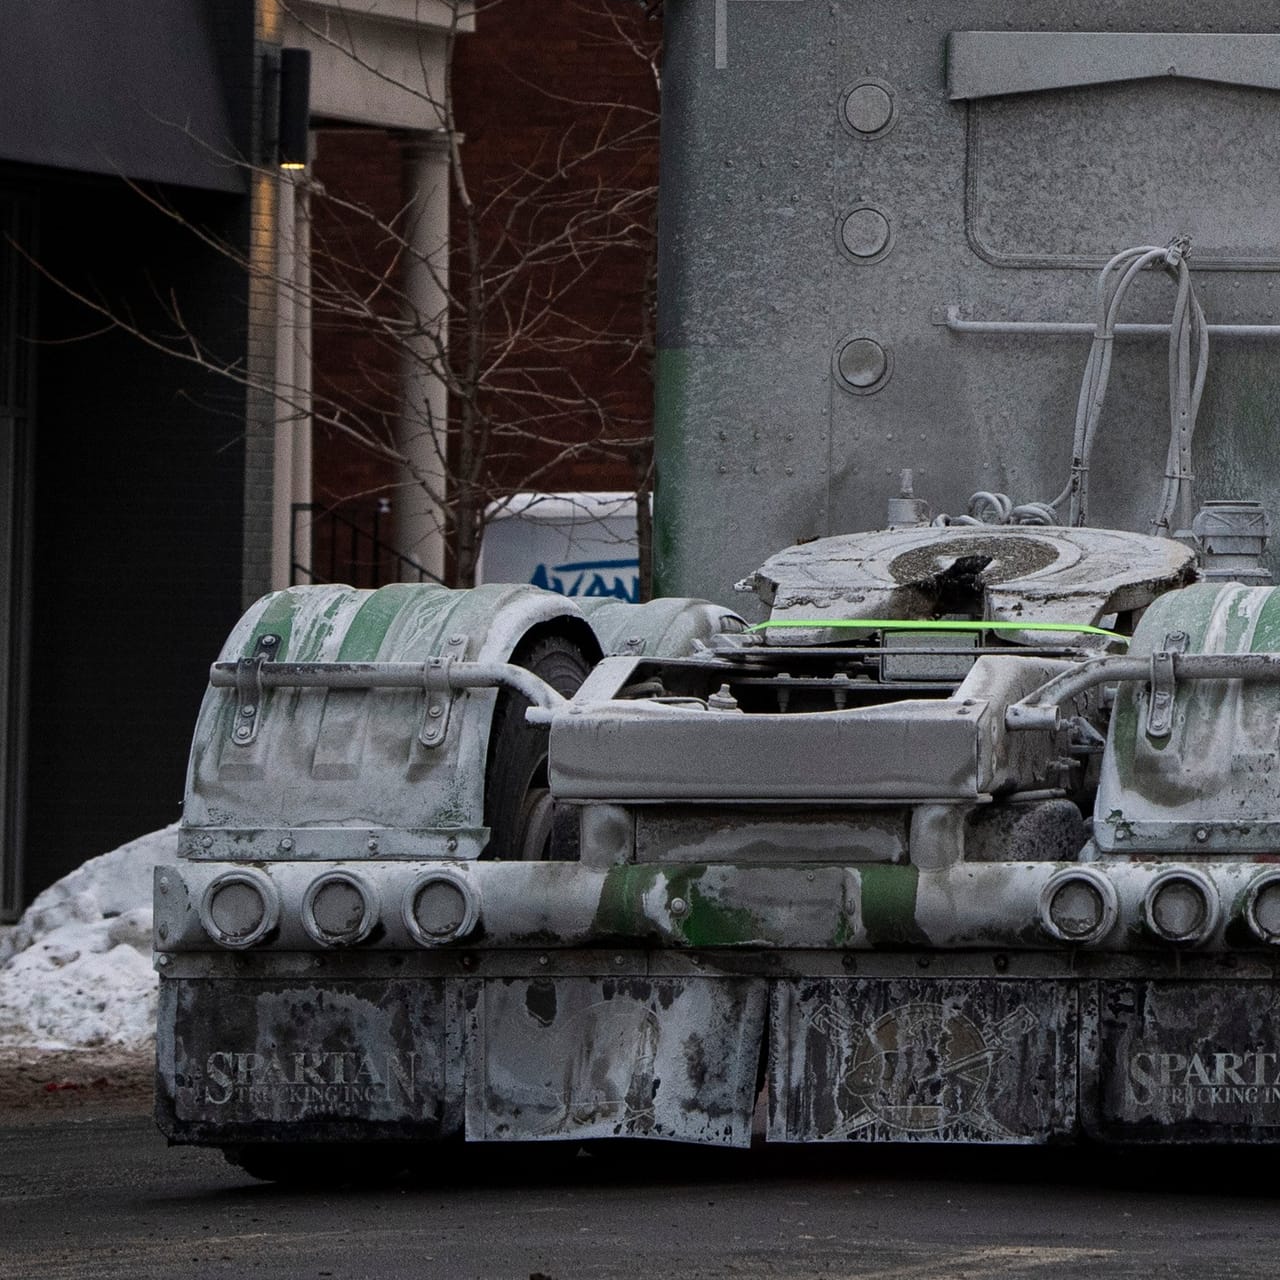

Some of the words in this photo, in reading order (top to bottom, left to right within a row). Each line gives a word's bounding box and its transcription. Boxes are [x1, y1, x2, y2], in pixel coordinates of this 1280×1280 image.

[205, 1051, 418, 1105] SPARTAN
[234, 1086, 338, 1104] TRUCKING
[1159, 1087, 1259, 1104] TRUCKING
